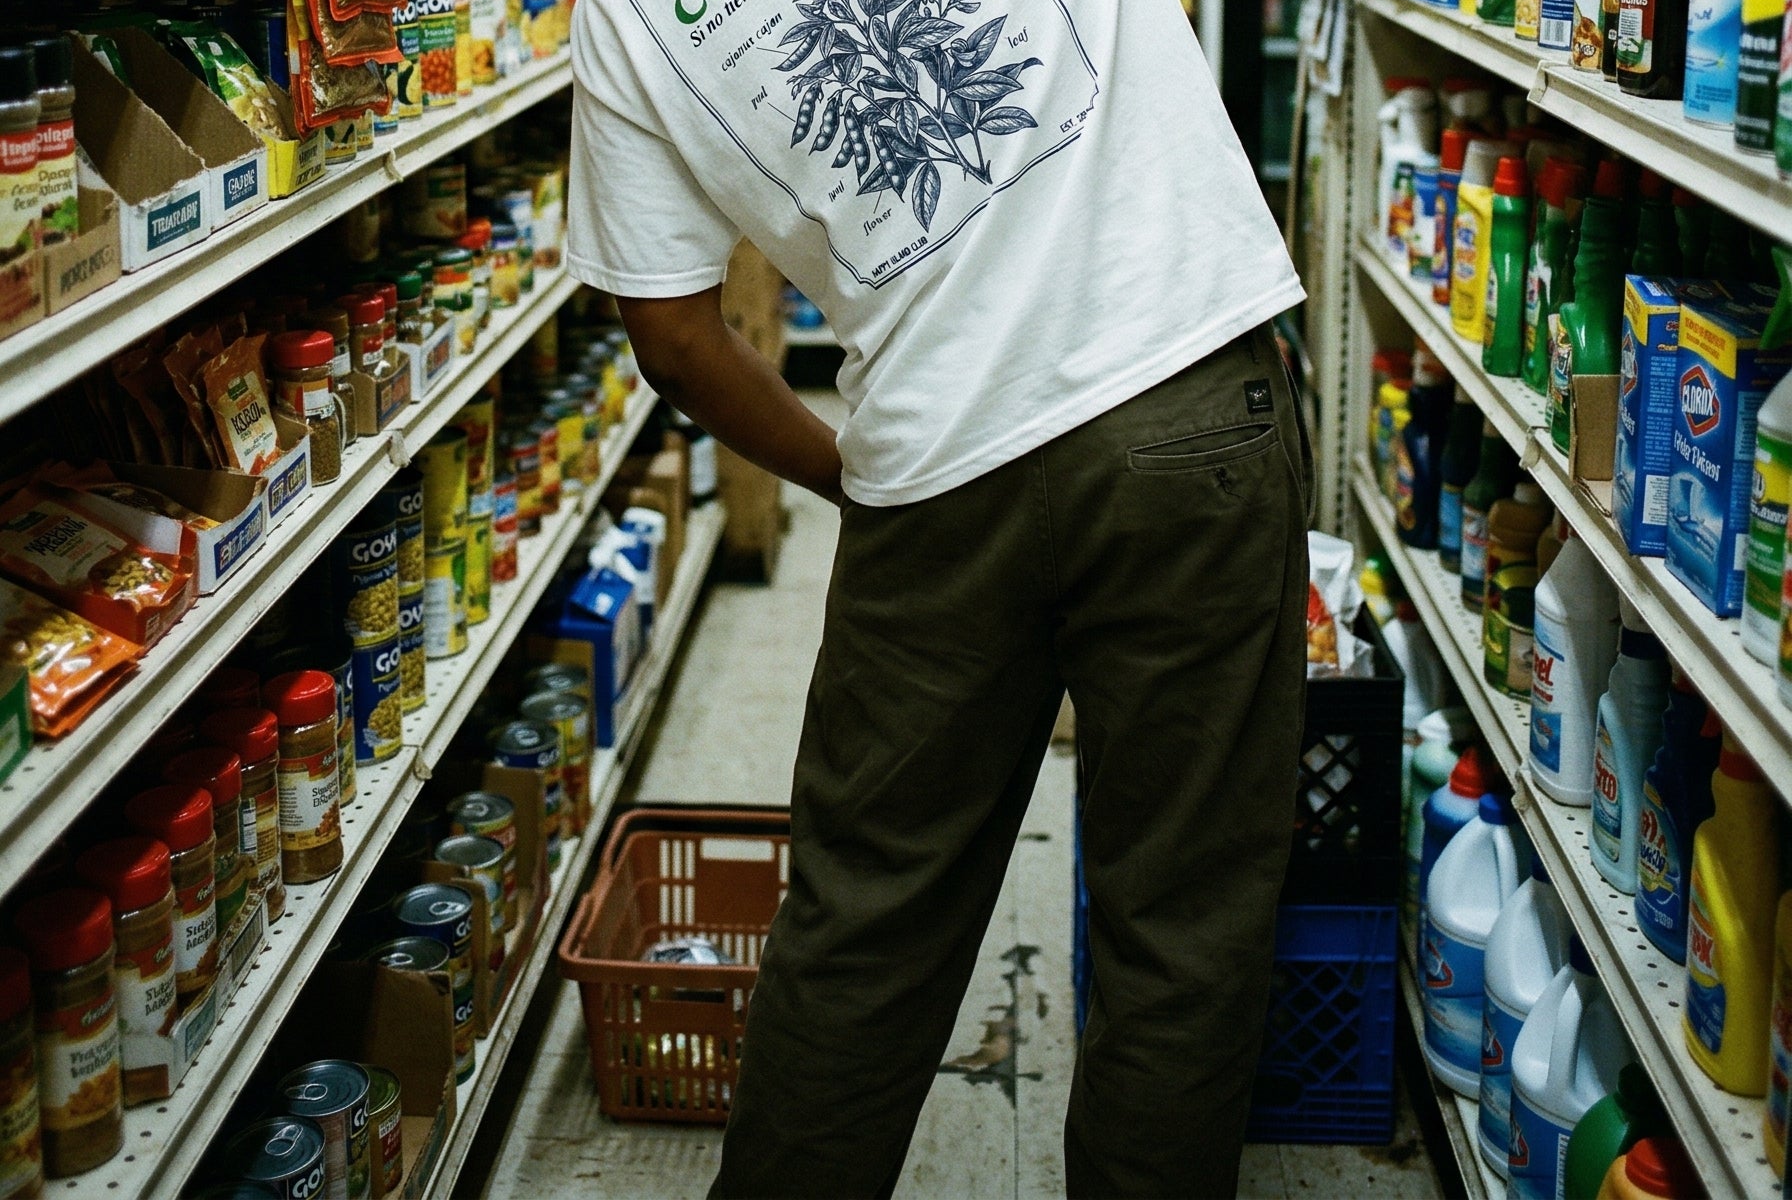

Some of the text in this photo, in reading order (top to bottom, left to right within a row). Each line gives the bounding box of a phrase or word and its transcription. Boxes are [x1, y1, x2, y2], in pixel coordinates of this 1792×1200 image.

[690, 25, 706, 48] Si
[706, 13, 723, 34] no
[1682, 385, 1715, 417] CLOROX
